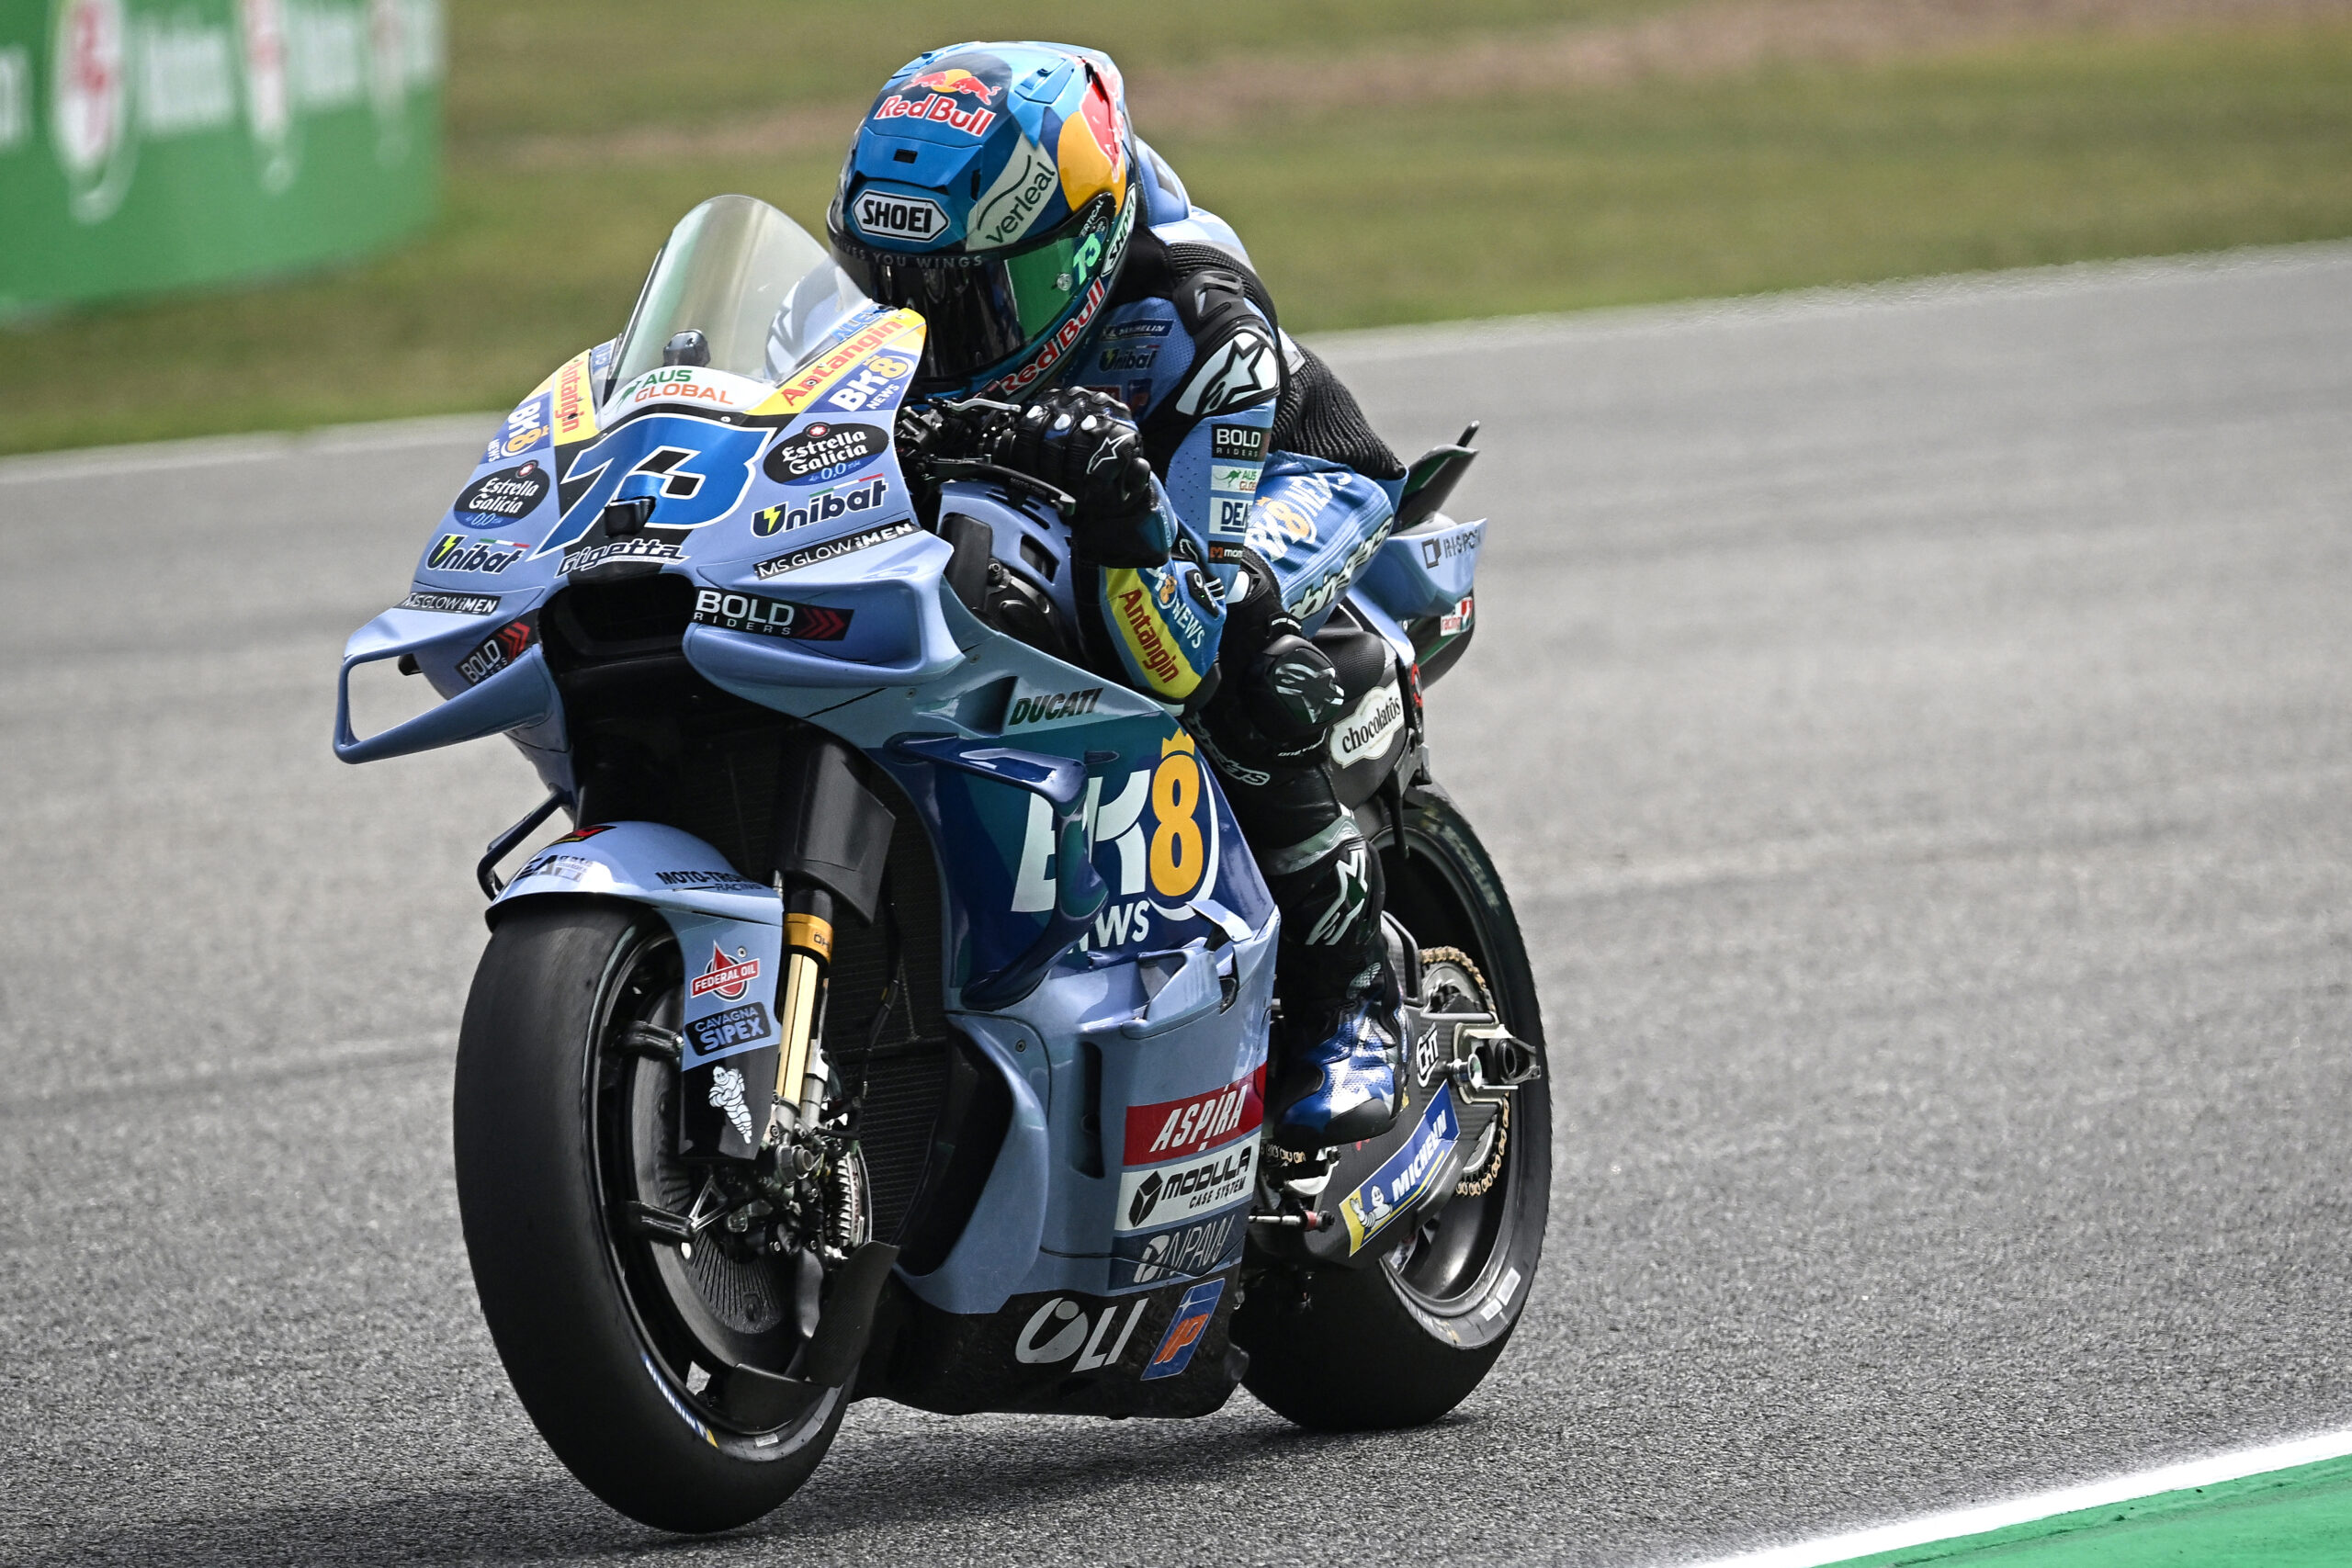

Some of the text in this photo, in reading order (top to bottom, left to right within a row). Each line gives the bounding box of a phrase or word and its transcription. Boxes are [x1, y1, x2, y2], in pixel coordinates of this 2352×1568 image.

[874, 93, 997, 137] Red Bull
[864, 199, 933, 233] SHOEI
[986, 161, 1056, 244] verleal
[874, 253, 906, 267] YOU
[918, 255, 983, 269] WINGS
[638, 369, 693, 386] AUS
[780, 319, 904, 406] Antangin
[634, 383, 735, 405] GLOBAL
[866, 384, 900, 411] NEWS
[781, 431, 867, 463] Estrella
[1216, 428, 1261, 447] BOLD
[1216, 446, 1259, 457] RIDERS
[789, 445, 869, 475] Galicia
[469, 492, 524, 514] Galicia
[479, 477, 540, 496] Estrella
[526, 412, 778, 562] 73
[752, 479, 888, 537] Unibat
[426, 534, 527, 574] Unibat
[554, 538, 691, 579] Gigetta
[756, 561, 789, 578] MS
[791, 538, 853, 568] GLOW
[862, 522, 914, 547] MEN
[402, 592, 498, 613] MS GLOW MEN
[695, 589, 797, 627] BOLD
[693, 611, 792, 636] RIDERS
[1118, 588, 1180, 683] Antangin
[1171, 598, 1205, 649] NEWS
[461, 639, 502, 683] BOLD
[1008, 687, 1104, 727] DUCATI
[694, 962, 757, 993] FEDERAL OIL
[695, 1006, 760, 1032] CAVAGNA
[699, 1017, 764, 1052] SIPEX
[1149, 1083, 1249, 1153] ASPIRA
[1161, 1145, 1252, 1201] MODULA
[1390, 1108, 1446, 1203] MICHELIN
[1189, 1176, 1247, 1210] CASE SYSTEM
